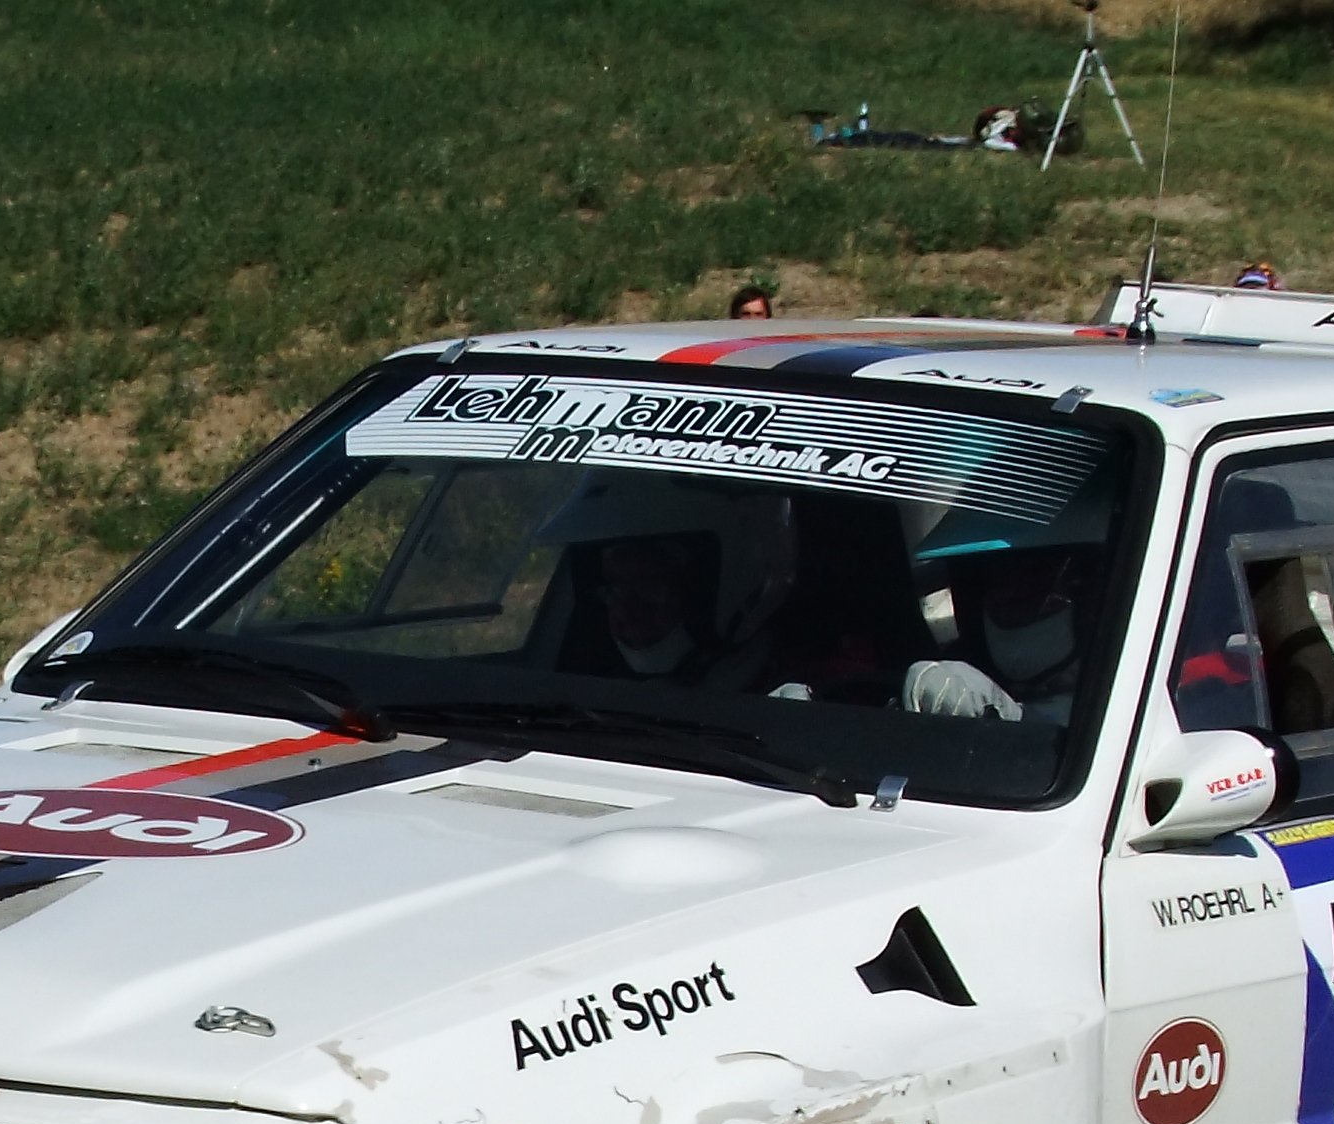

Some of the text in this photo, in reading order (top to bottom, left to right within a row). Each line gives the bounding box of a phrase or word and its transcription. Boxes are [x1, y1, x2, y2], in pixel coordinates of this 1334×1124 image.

[497, 340, 628, 353] Audi
[901, 369, 1046, 389] Audi
[404, 375, 781, 441] Lehmann
[830, 452, 898, 481] AG
[509, 961, 736, 1071] Audi Sport
[1138, 1042, 1222, 1101] Audi
